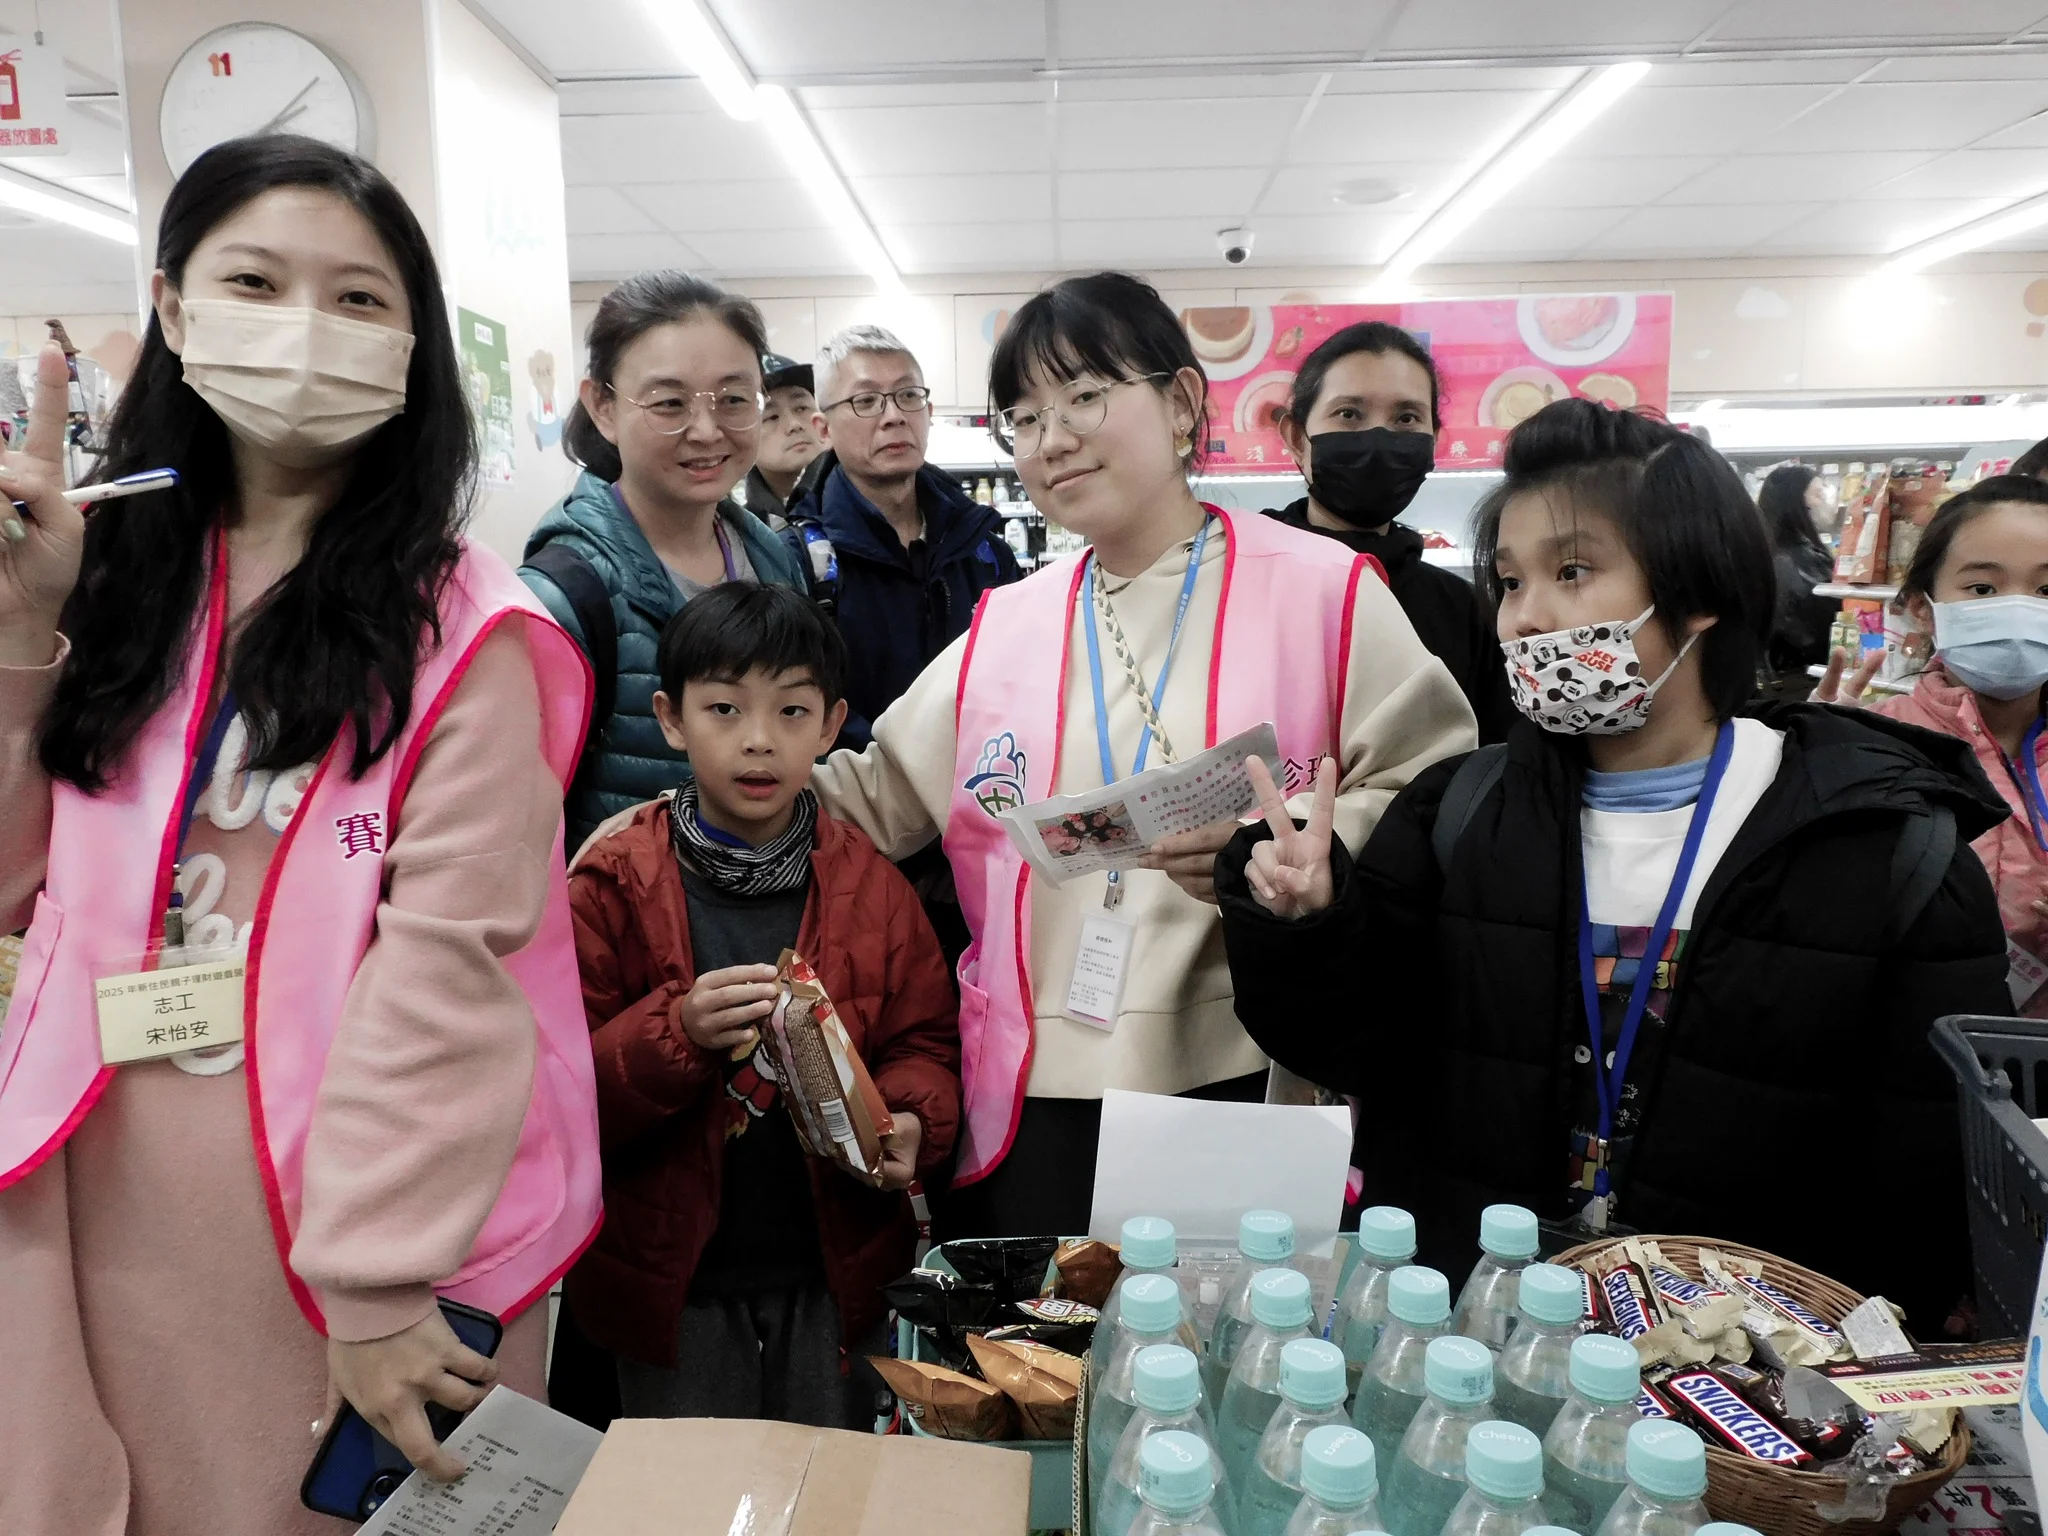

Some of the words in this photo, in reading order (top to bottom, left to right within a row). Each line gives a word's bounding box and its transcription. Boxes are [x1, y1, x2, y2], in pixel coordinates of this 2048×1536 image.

[208, 52, 232, 77] 11
[336, 812, 382, 859] 賽
[98, 986, 124, 999] 2025
[153, 992, 196, 1015] 志工
[146, 1020, 210, 1045] 宋怡安
[1603, 1270, 1648, 1341] SNICKERS
[1580, 1339, 1629, 1357] Cheers
[1677, 1376, 1797, 1461] SNICKERS
[1478, 1429, 1531, 1446] Cheers
